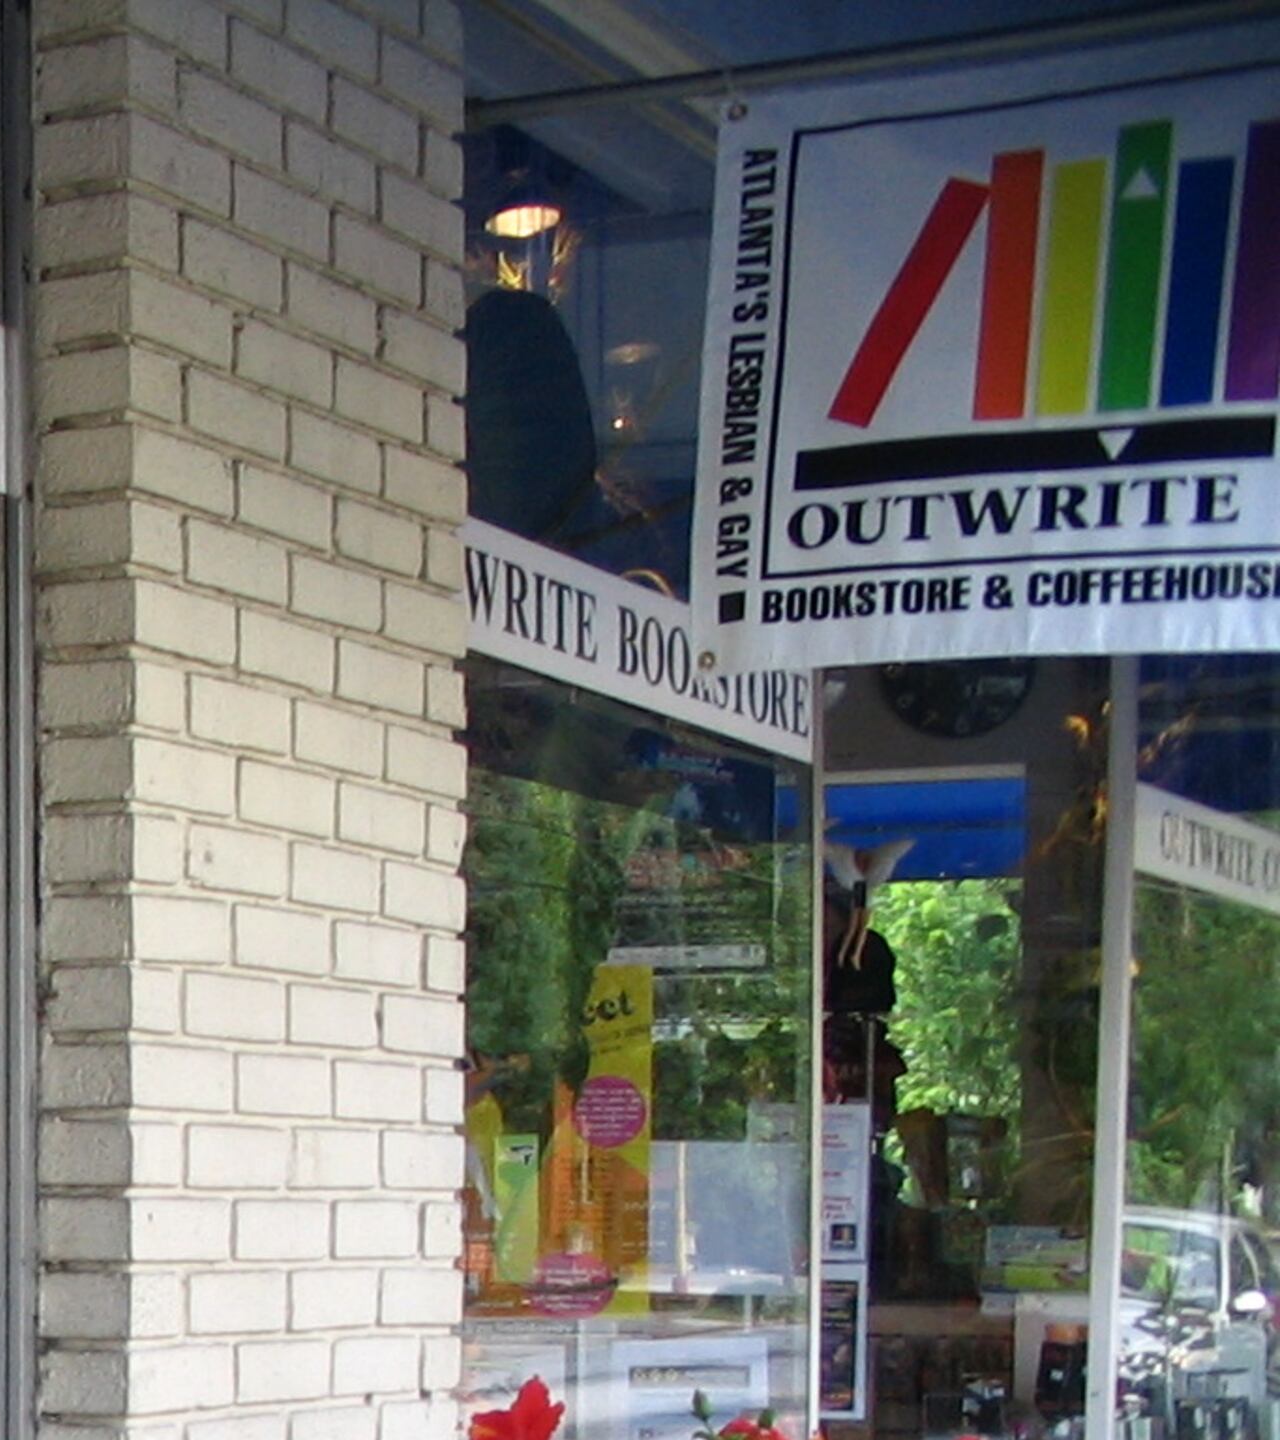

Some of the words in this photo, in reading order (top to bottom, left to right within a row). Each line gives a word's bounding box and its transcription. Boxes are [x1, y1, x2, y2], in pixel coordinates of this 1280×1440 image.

[732, 149, 778, 323] ATLANTA'S
[722, 332, 766, 465] LESBIAN
[719, 476, 754, 506] &
[787, 474, 1240, 550] OUTWRITE
[716, 512, 751, 578] GAY
[464, 546, 598, 664] WRITE
[761, 577, 971, 624] BOOKSTORE
[982, 574, 1014, 609] &
